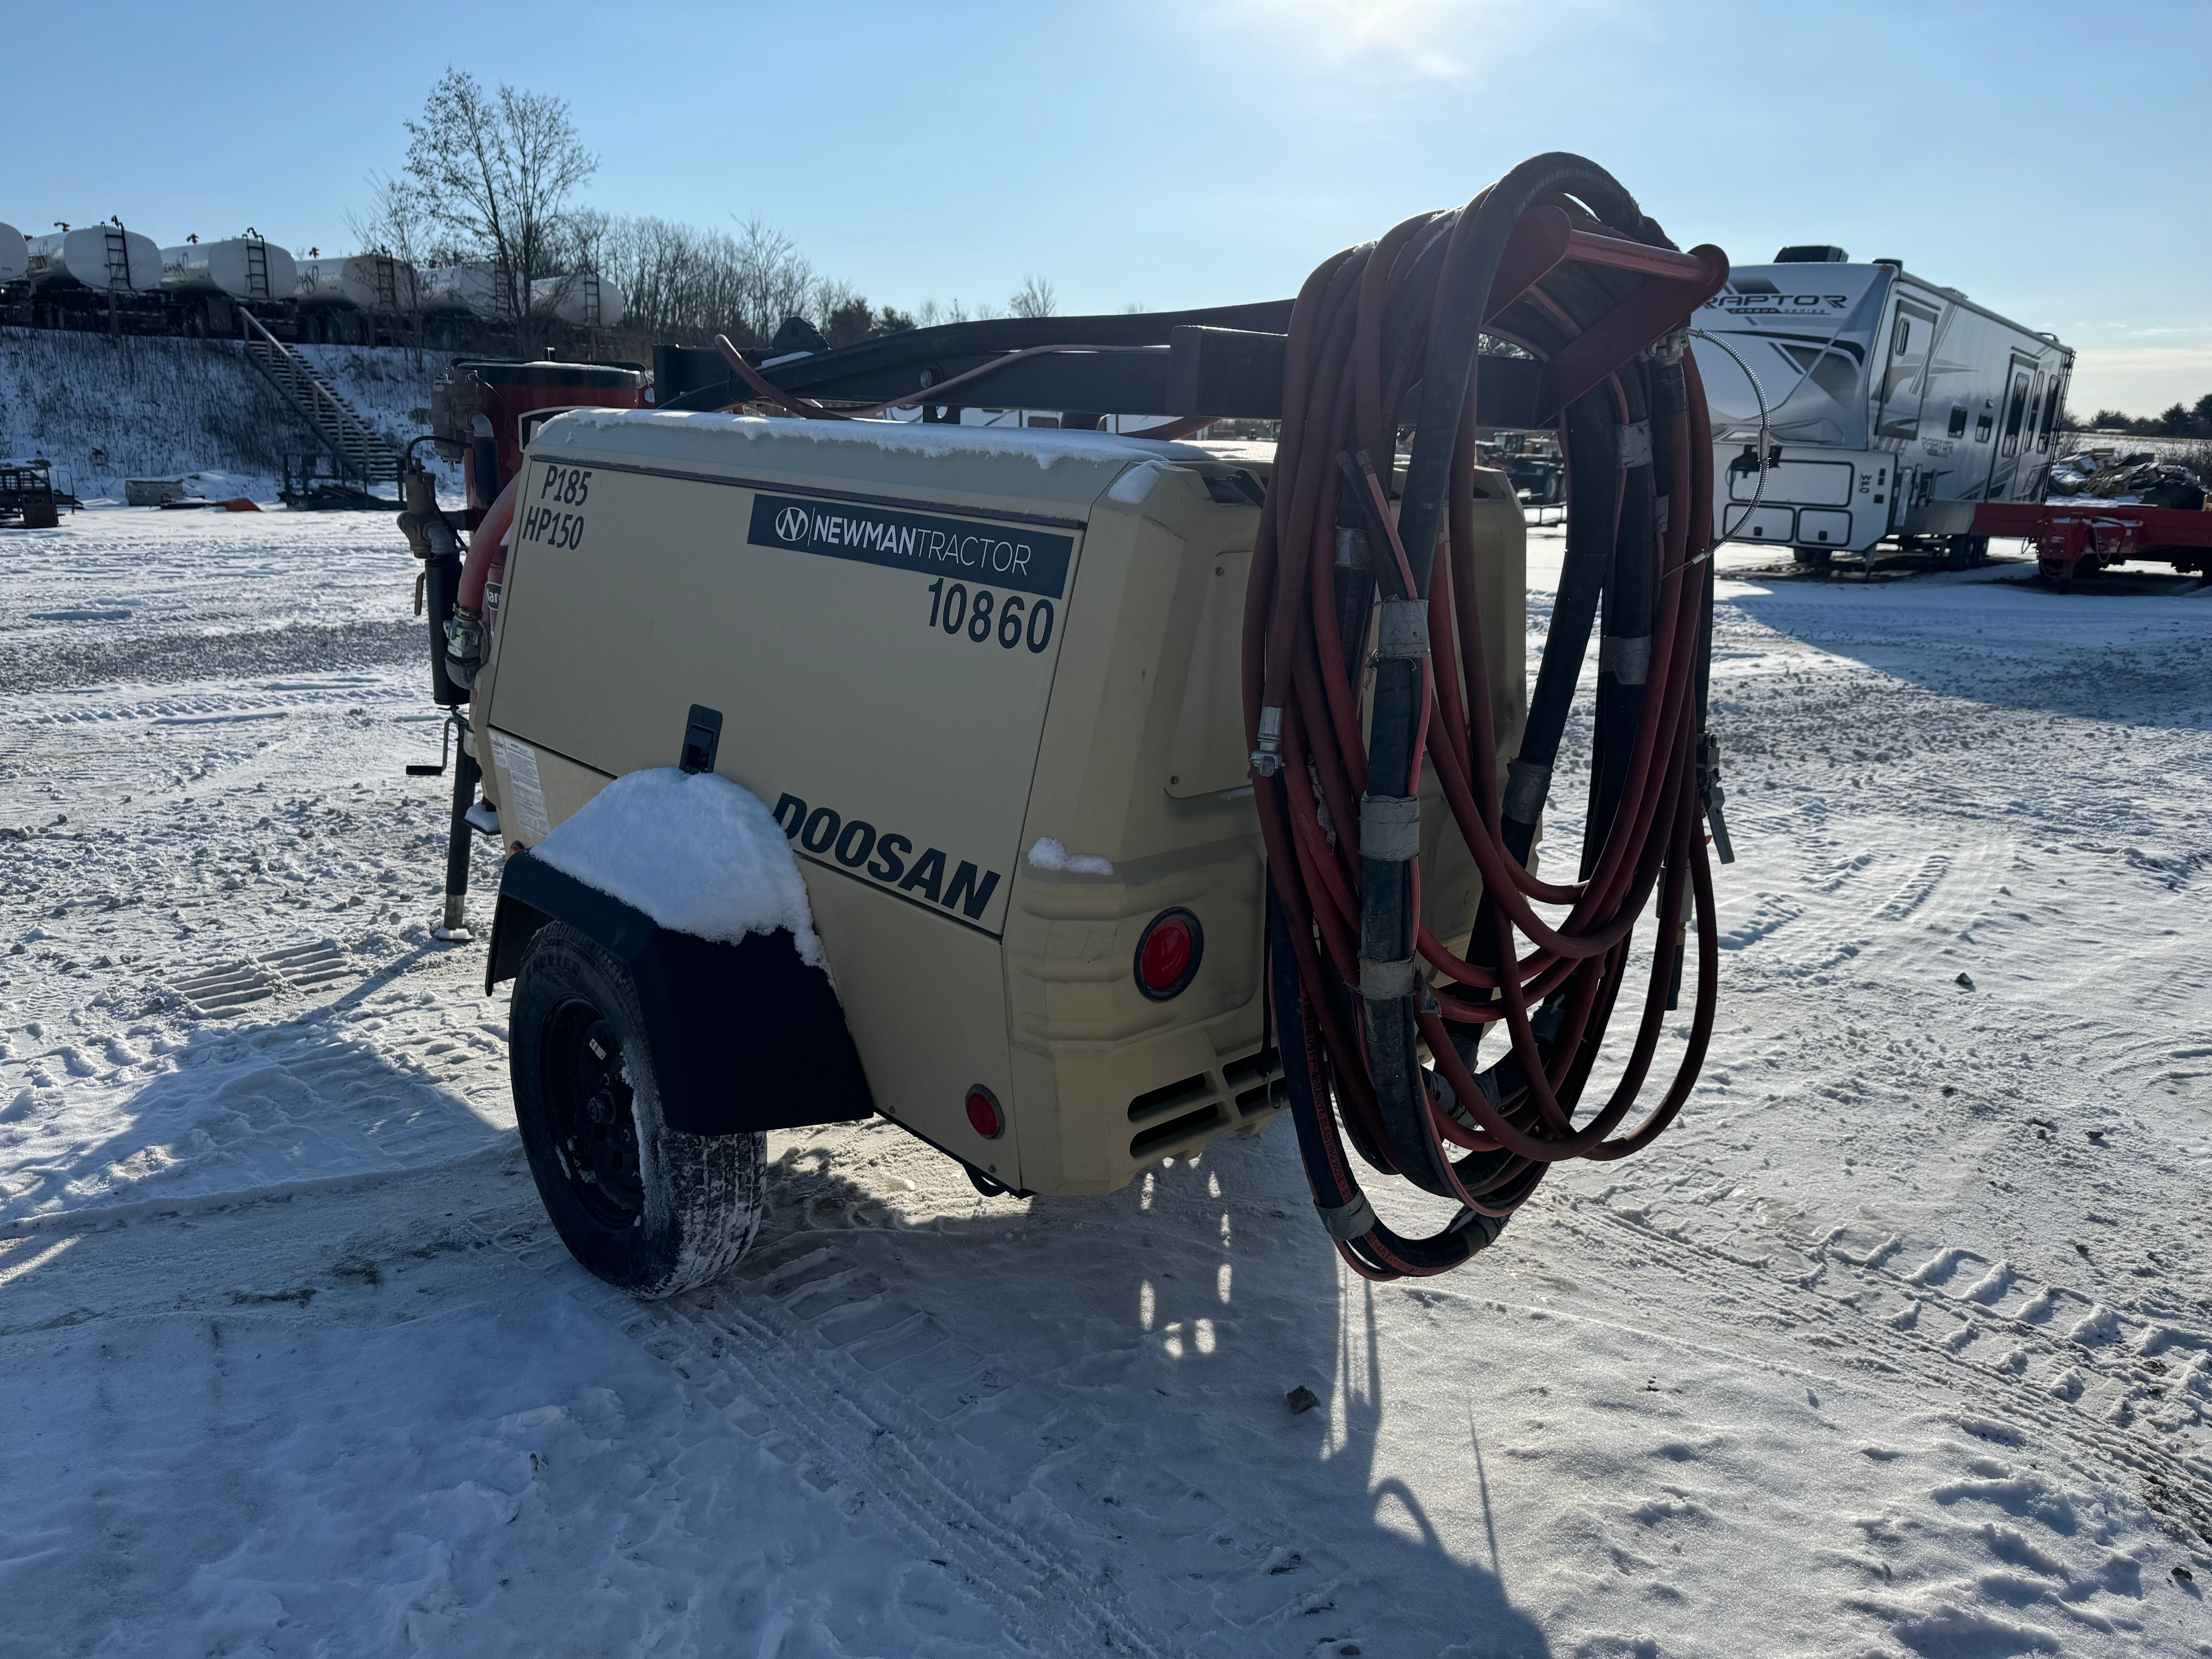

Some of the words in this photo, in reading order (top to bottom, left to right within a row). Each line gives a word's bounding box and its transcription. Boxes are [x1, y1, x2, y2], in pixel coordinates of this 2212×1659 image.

[1703, 295, 1848, 309] RAPTOR
[541, 465, 592, 507] P185
[522, 506, 584, 550] HP150
[928, 577, 1054, 654] 10860
[772, 792, 1001, 921] DOOSAN
[1312, 1072, 1326, 1116] ABRASIVE
[1321, 1117, 1337, 1160] BLASTING
[1332, 1161, 1345, 1185] HOSE
